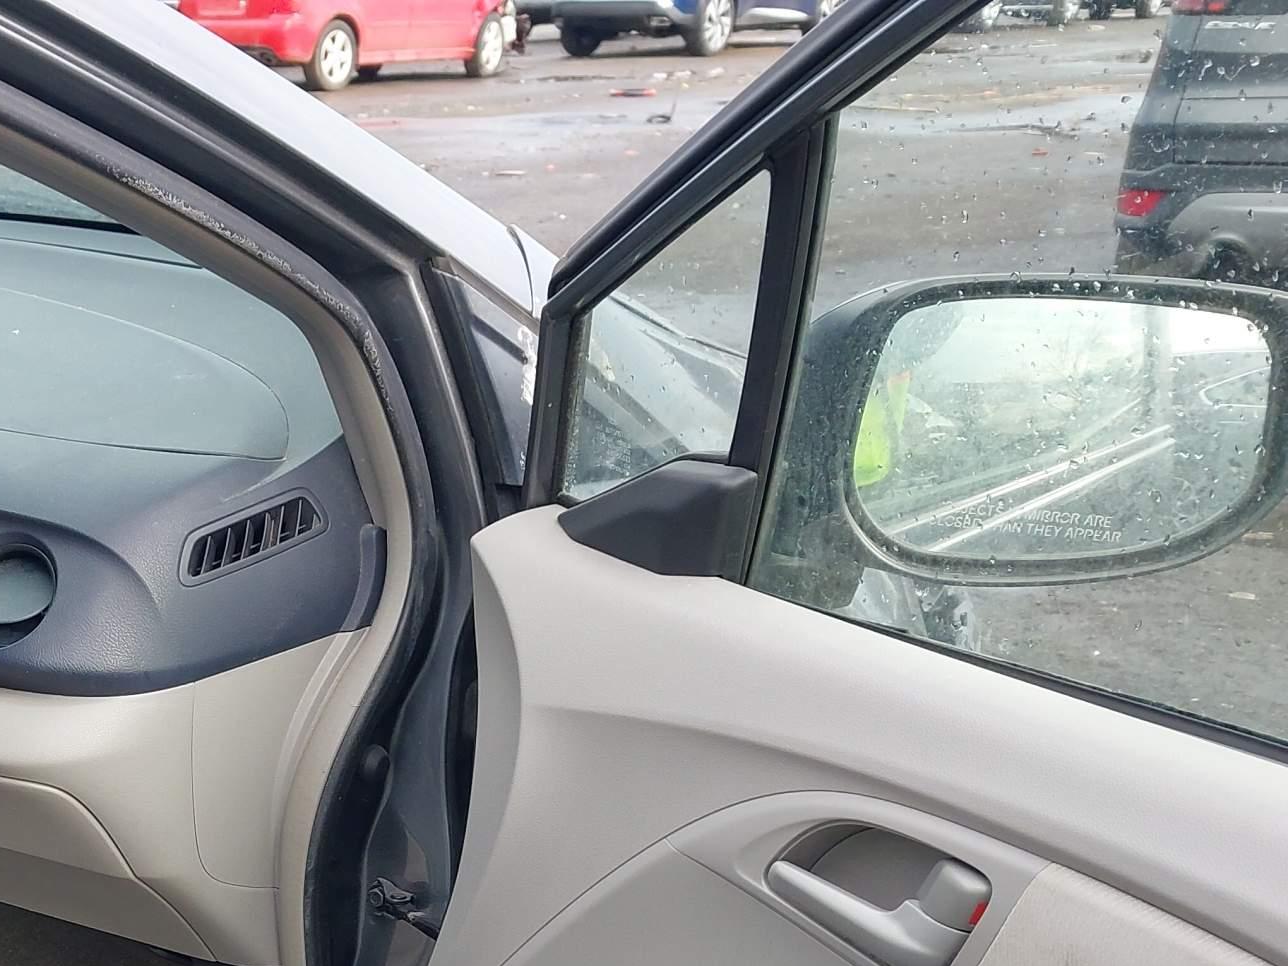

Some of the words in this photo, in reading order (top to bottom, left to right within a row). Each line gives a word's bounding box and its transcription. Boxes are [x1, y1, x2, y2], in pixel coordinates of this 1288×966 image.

[1023, 509, 1081, 524] MIRROR
[1083, 513, 1113, 528] ARE
[1025, 522, 1064, 537] THEY
[1064, 526, 1122, 543] APPEAR
